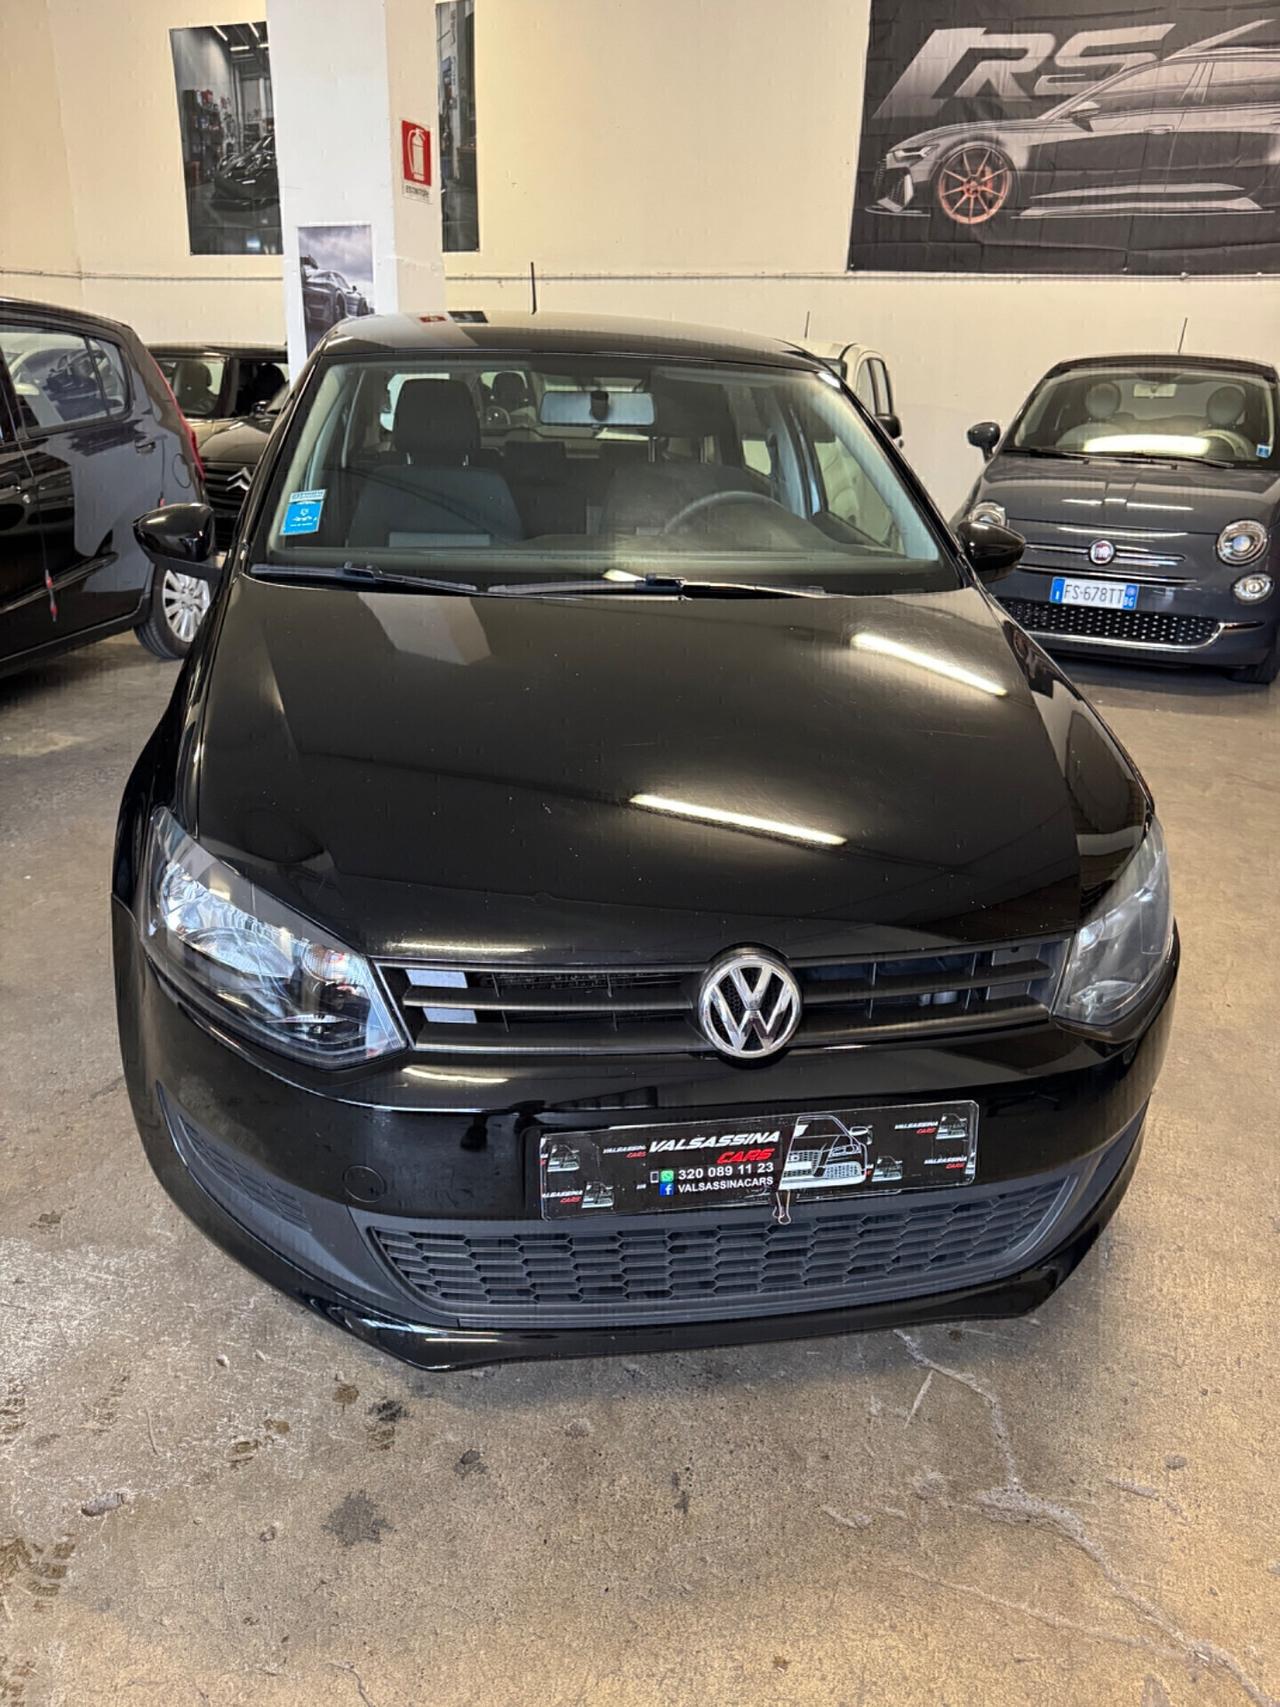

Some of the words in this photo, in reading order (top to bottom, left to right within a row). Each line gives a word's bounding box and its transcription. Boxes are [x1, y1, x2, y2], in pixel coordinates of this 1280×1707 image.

[873, 23, 1176, 119] RS
[649, 1131, 781, 1153] VALSASSINA
[716, 1148, 776, 1165] CARS
[678, 1168, 704, 1180] 320
[708, 1165, 733, 1177] 089
[738, 1164, 752, 1175] 11
[757, 1162, 774, 1173] 23
[678, 1176, 774, 1193] VALSASSINACARS
